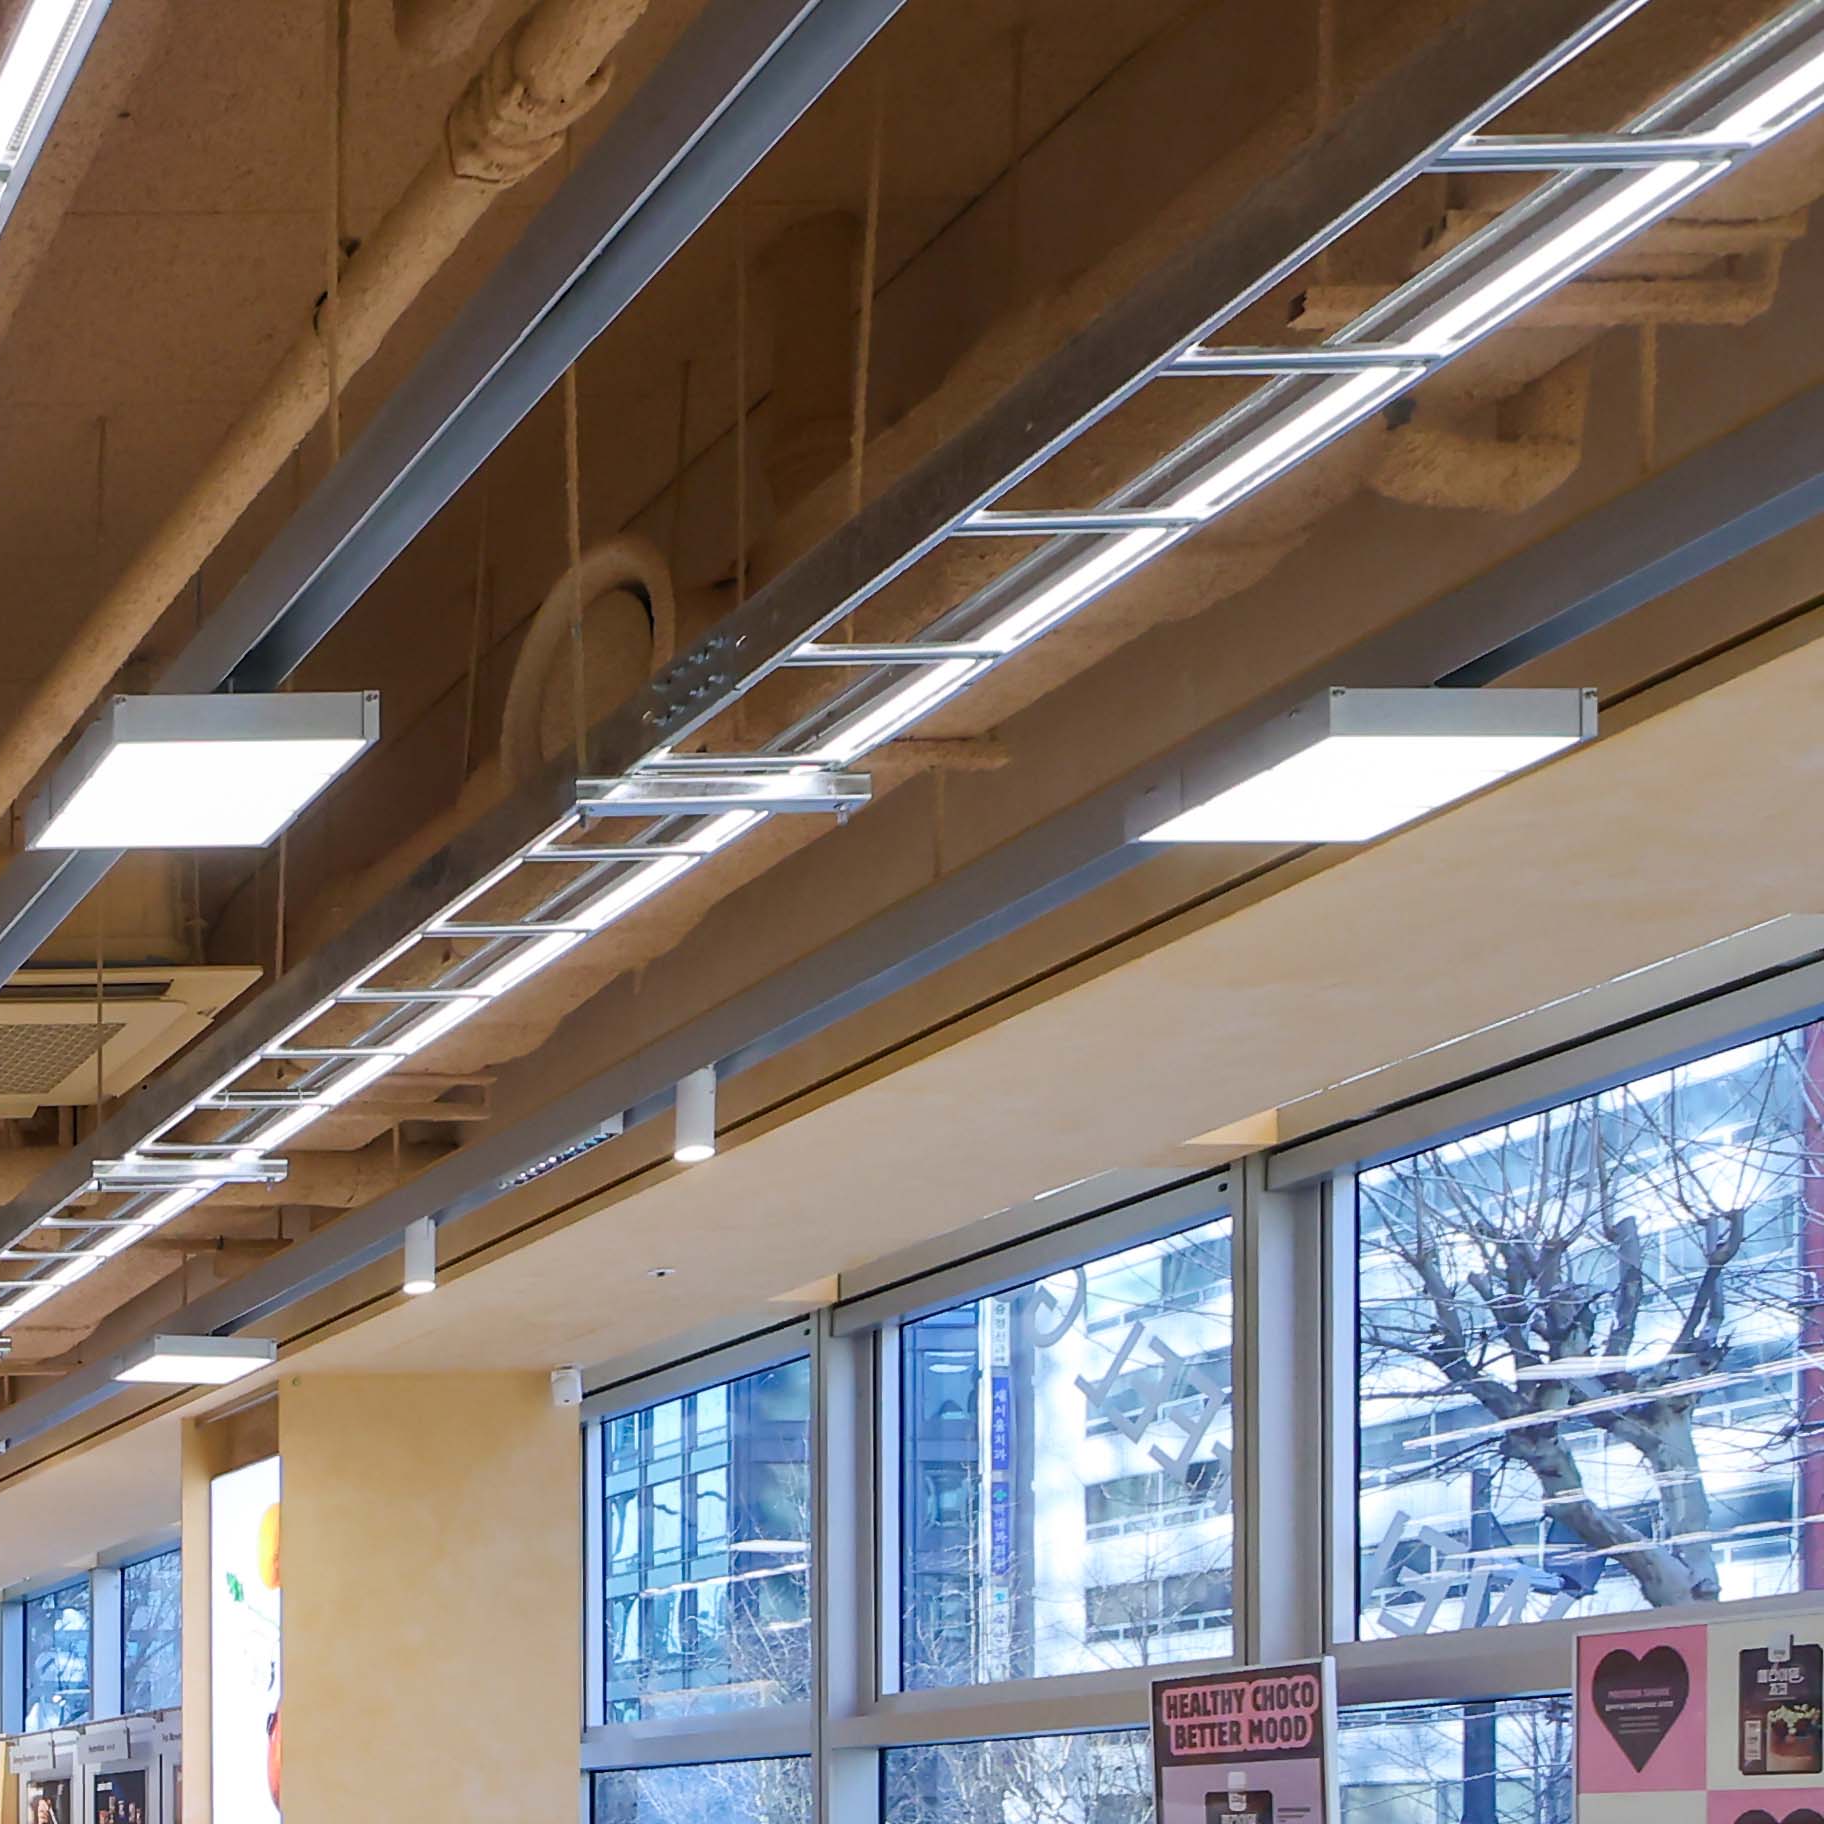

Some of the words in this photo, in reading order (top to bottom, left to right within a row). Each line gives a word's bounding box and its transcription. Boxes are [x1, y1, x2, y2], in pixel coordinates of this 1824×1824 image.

[1165, 1685, 1246, 1719] HEALTHY
[1252, 1681, 1314, 1713] CHOCO
[1174, 1719, 1242, 1750] BETTER
[1249, 1715, 1307, 1745] MOOD
